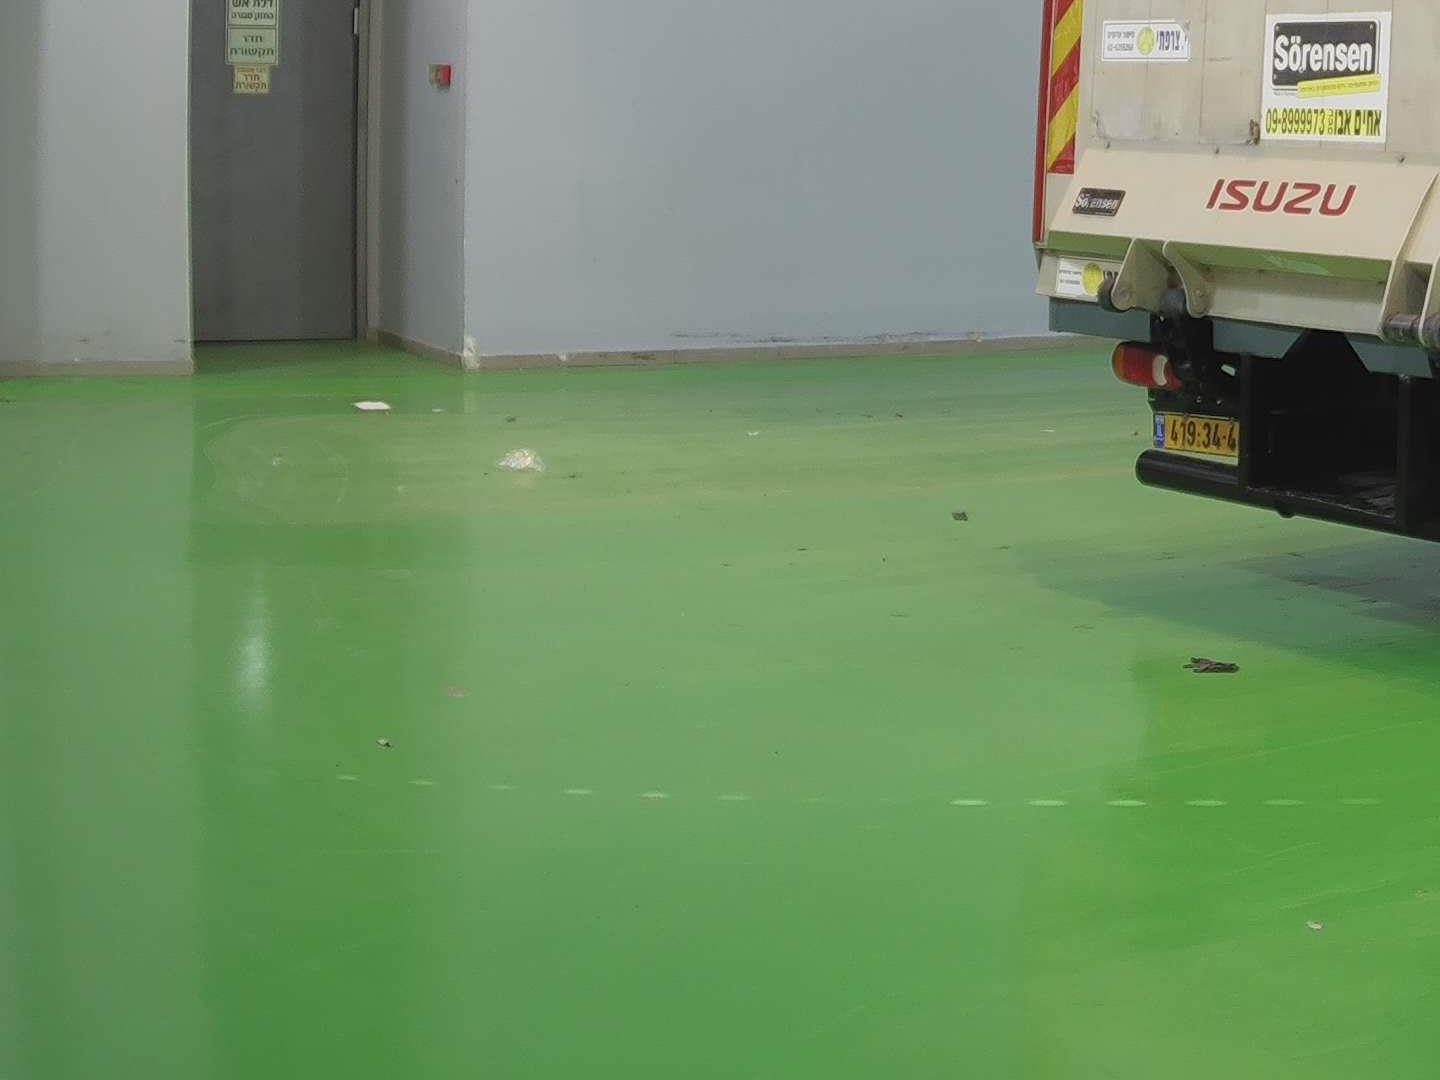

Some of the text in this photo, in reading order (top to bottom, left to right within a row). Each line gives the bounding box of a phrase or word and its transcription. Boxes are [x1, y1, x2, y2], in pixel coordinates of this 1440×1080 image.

[232, 0, 250, 9] אש
[242, 35, 263, 43] חדר
[1274, 34, 1373, 73] Sörensen
[1265, 107, 1325, 135] 09-8999973
[1354, 109, 1382, 136] אחים
[1206, 178, 1357, 216] ISUZU
